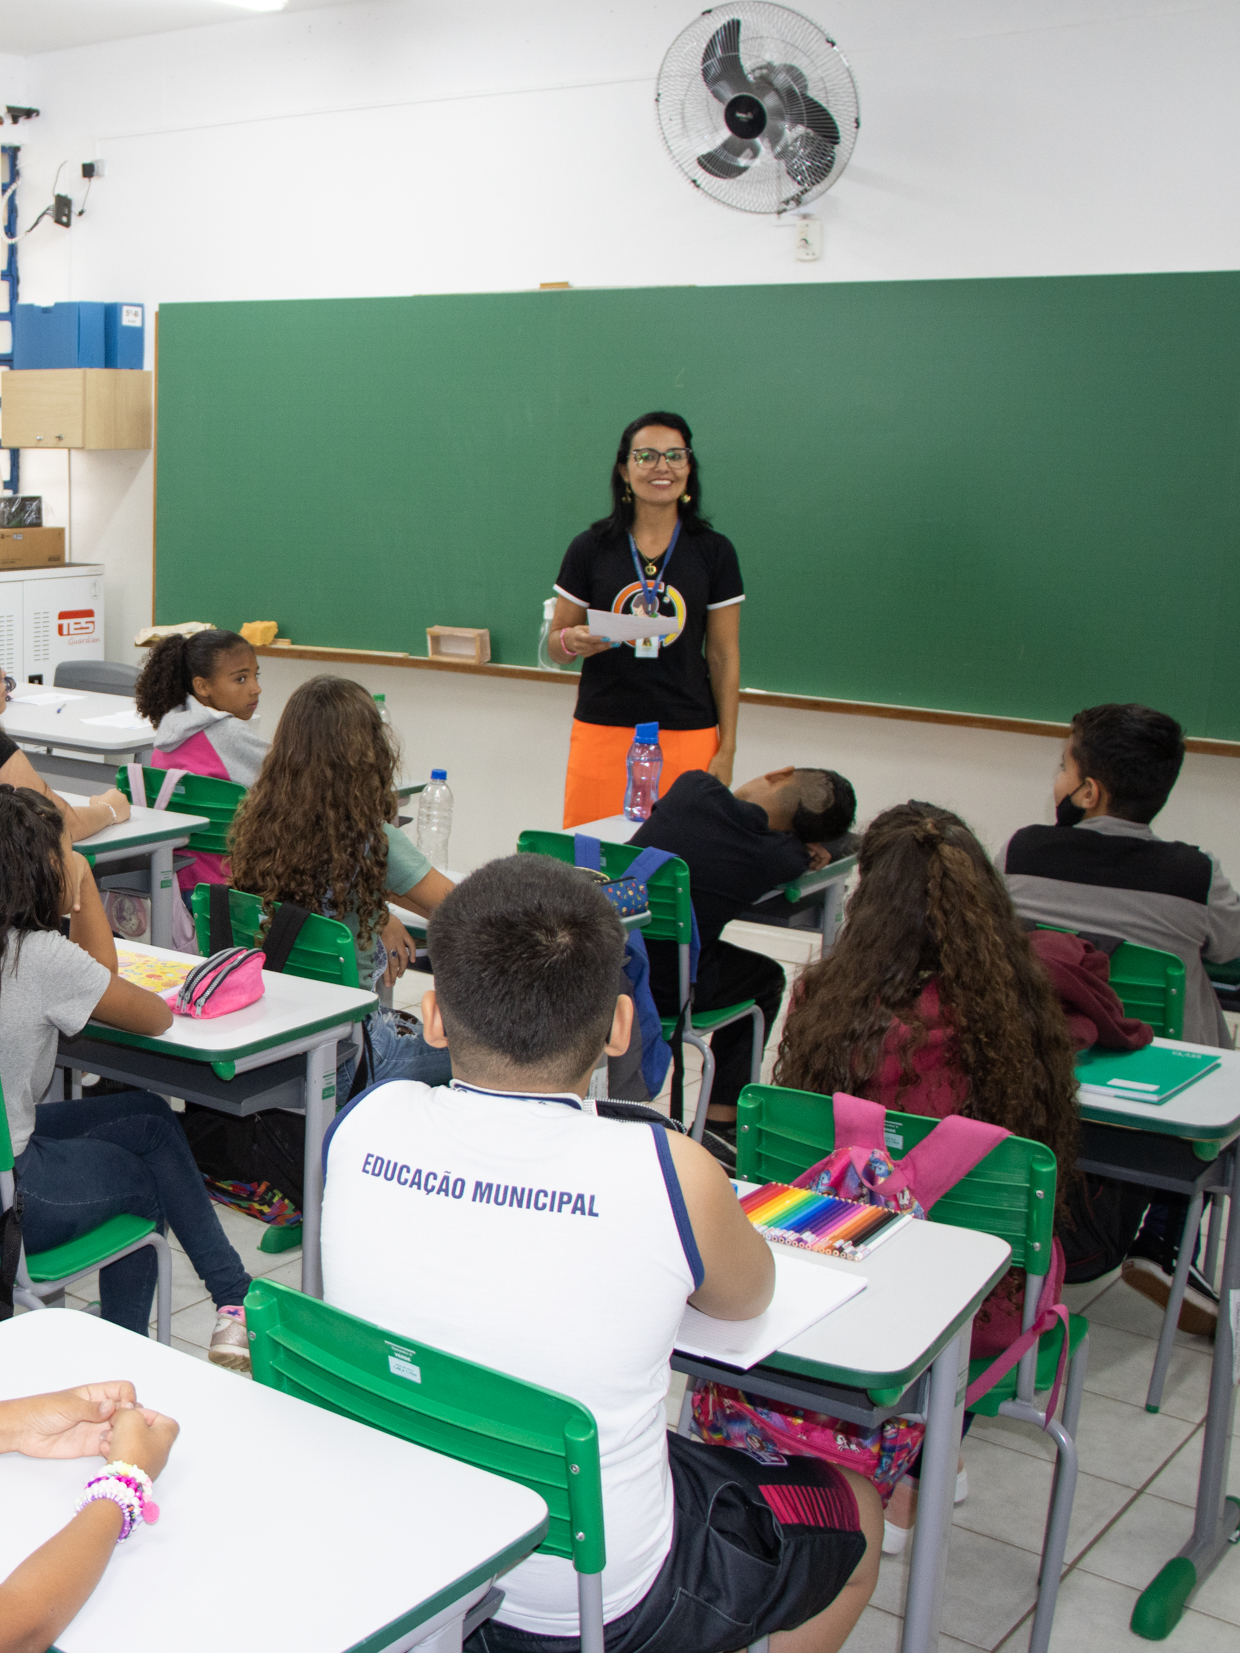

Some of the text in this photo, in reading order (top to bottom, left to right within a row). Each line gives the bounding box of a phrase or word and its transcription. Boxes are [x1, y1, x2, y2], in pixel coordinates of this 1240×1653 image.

[57, 615, 95, 637] TES
[68, 635, 100, 645] Guardian
[362, 1153, 600, 1218] EDUCAÇÃO MUNICIPAL
